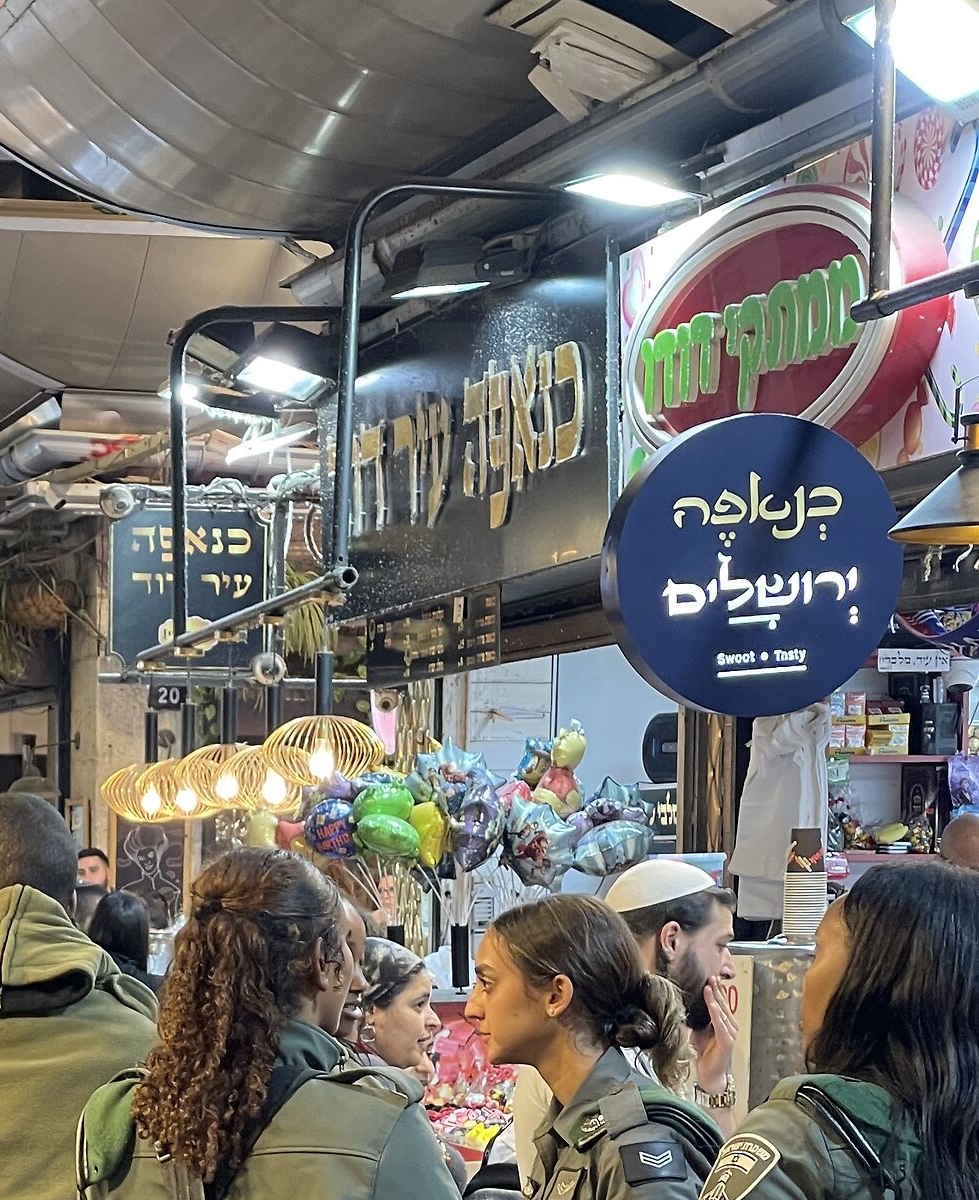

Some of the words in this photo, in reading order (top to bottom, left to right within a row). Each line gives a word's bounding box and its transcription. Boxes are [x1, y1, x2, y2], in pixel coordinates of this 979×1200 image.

[641, 312, 721, 415] דודו
[724, 254, 866, 413] ממתקי
[392, 392, 454, 530] עיר
[462, 340, 585, 530] כנאפה
[200, 571, 253, 599] עיר
[158, 687, 181, 705] 20
[316, 819, 348, 840] HAPPY
